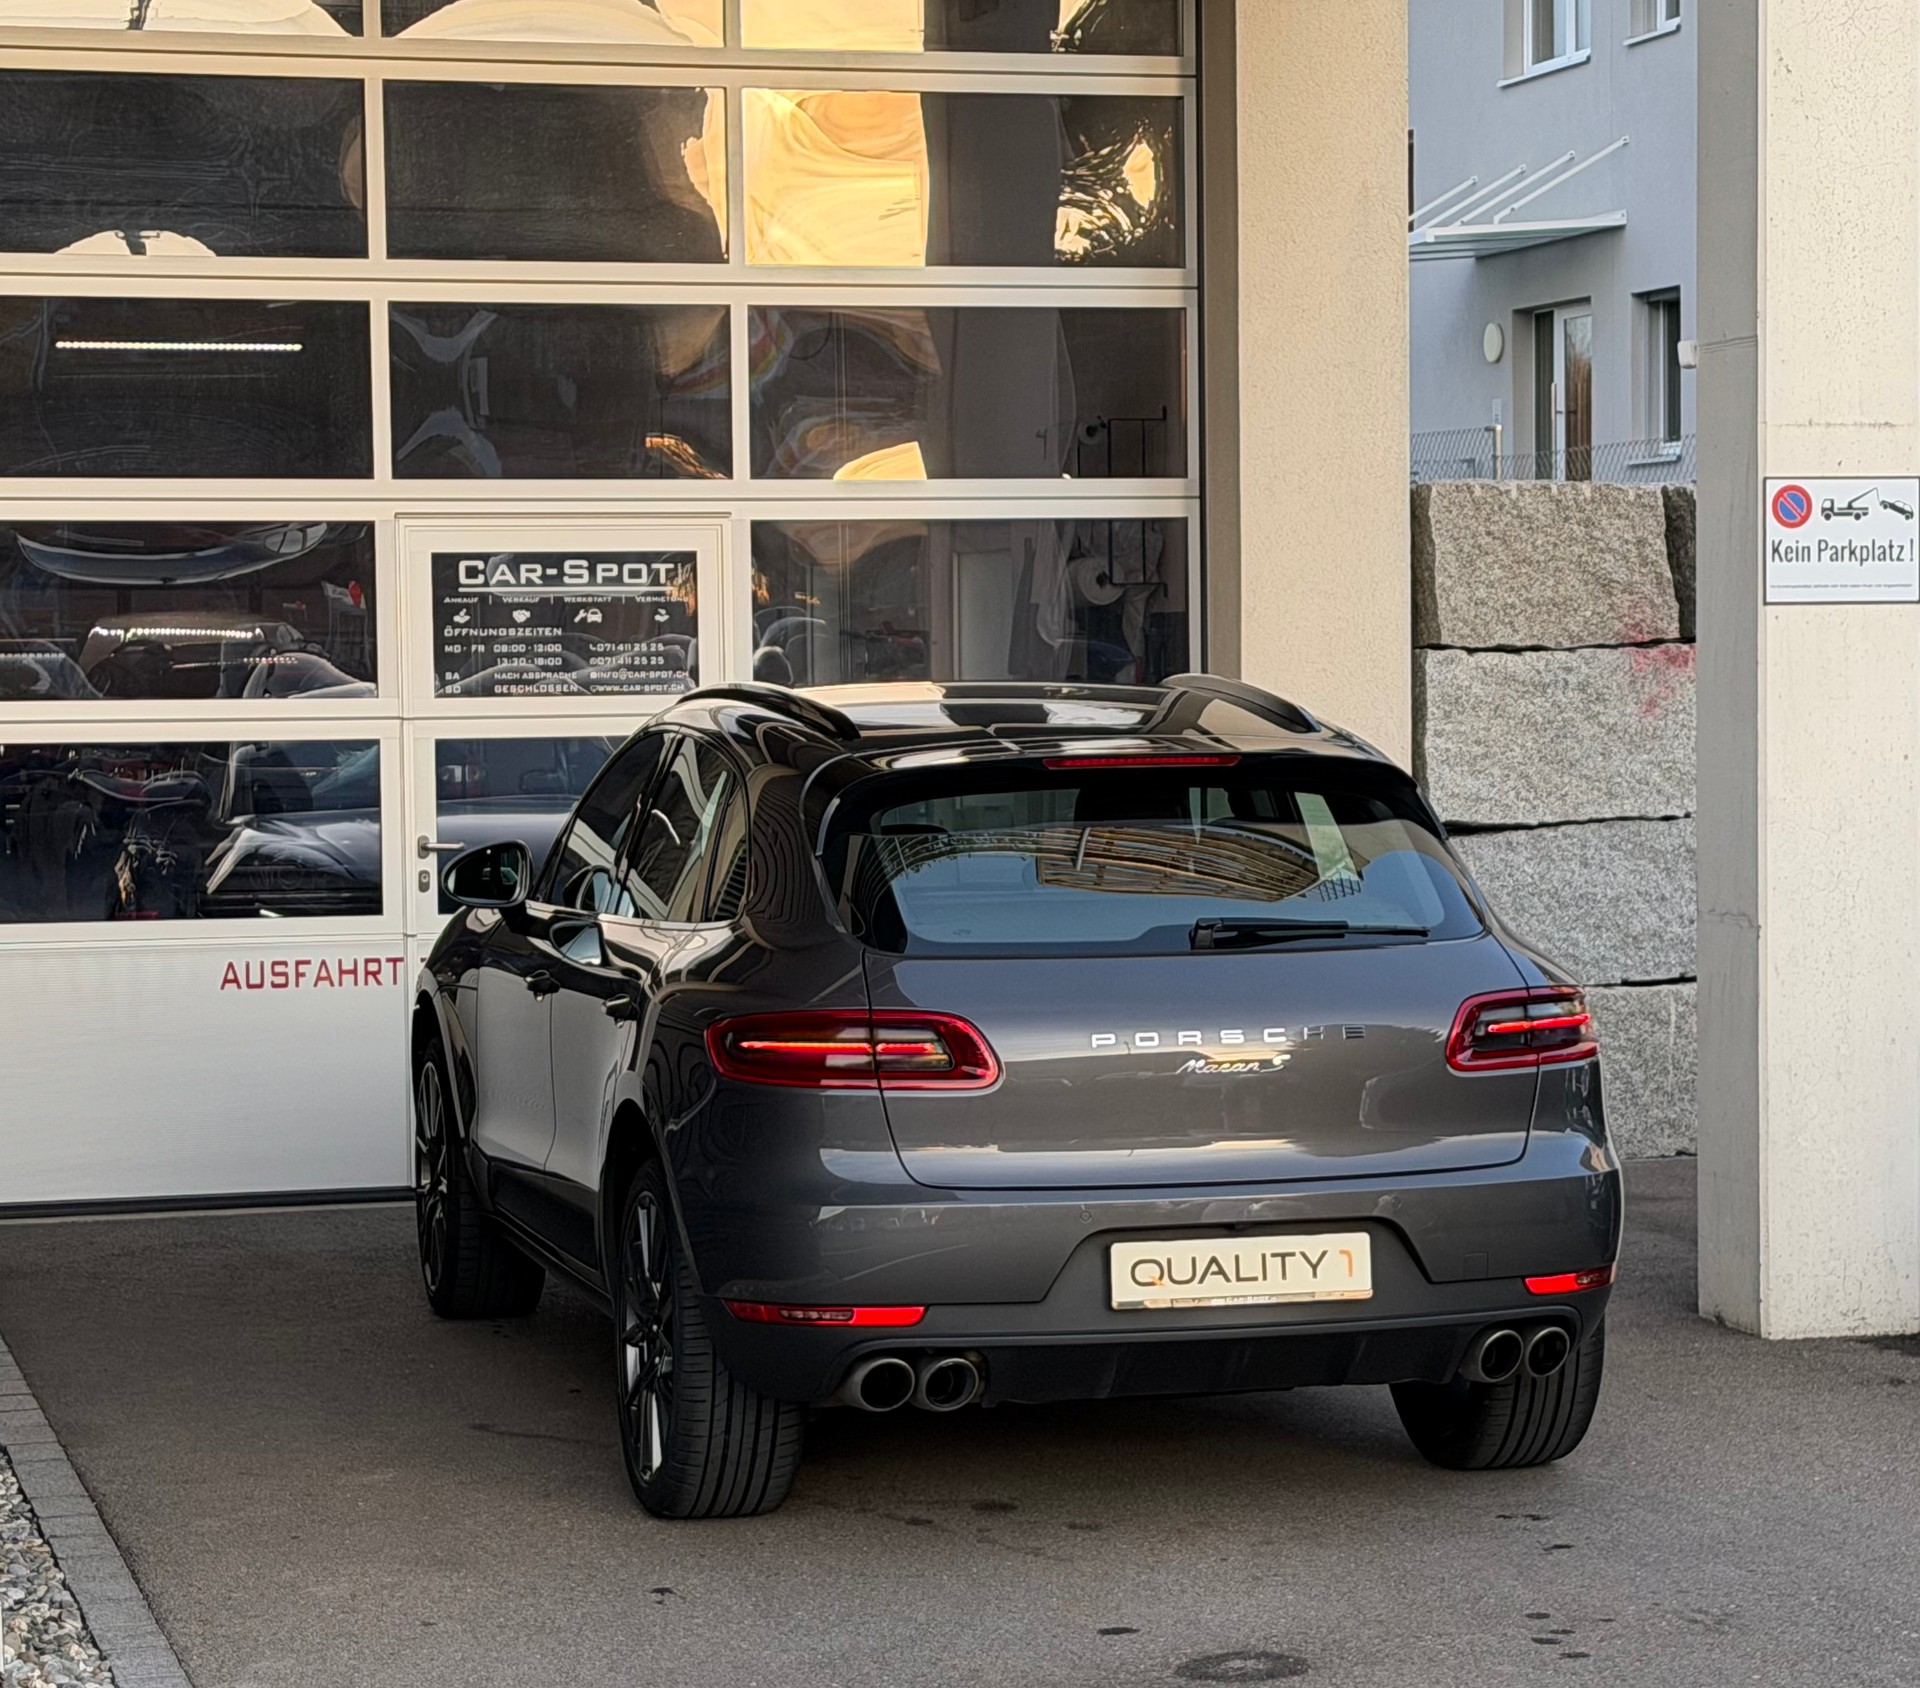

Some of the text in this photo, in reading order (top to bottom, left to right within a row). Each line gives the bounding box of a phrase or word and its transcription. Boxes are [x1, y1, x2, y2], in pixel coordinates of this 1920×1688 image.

[1771, 539, 1811, 563] Kein
[458, 559, 674, 585] CAR-SPOT
[444, 625, 562, 637] ÖFFNUNGSZEITEN
[444, 644, 461, 653] MO
[471, 644, 485, 653] FR
[493, 644, 526, 653] 08:00
[533, 643, 562, 652] 12:00
[633, 643, 647, 651] 25
[650, 643, 664, 651] 25
[497, 657, 526, 666] 13:30
[534, 657, 562, 666] 18:00
[633, 657, 647, 665] 25
[650, 656, 664, 665] 25
[445, 672, 460, 680] SA
[445, 685, 461, 693] SO
[494, 684, 578, 693] GESCHLOSSEN
[220, 957, 404, 991] AUSFAHRT
[1091, 1024, 1365, 1048] PORSCHE
[1176, 1058, 1260, 1075] Macan
[1130, 1249, 1354, 1287] QUALITY 1
